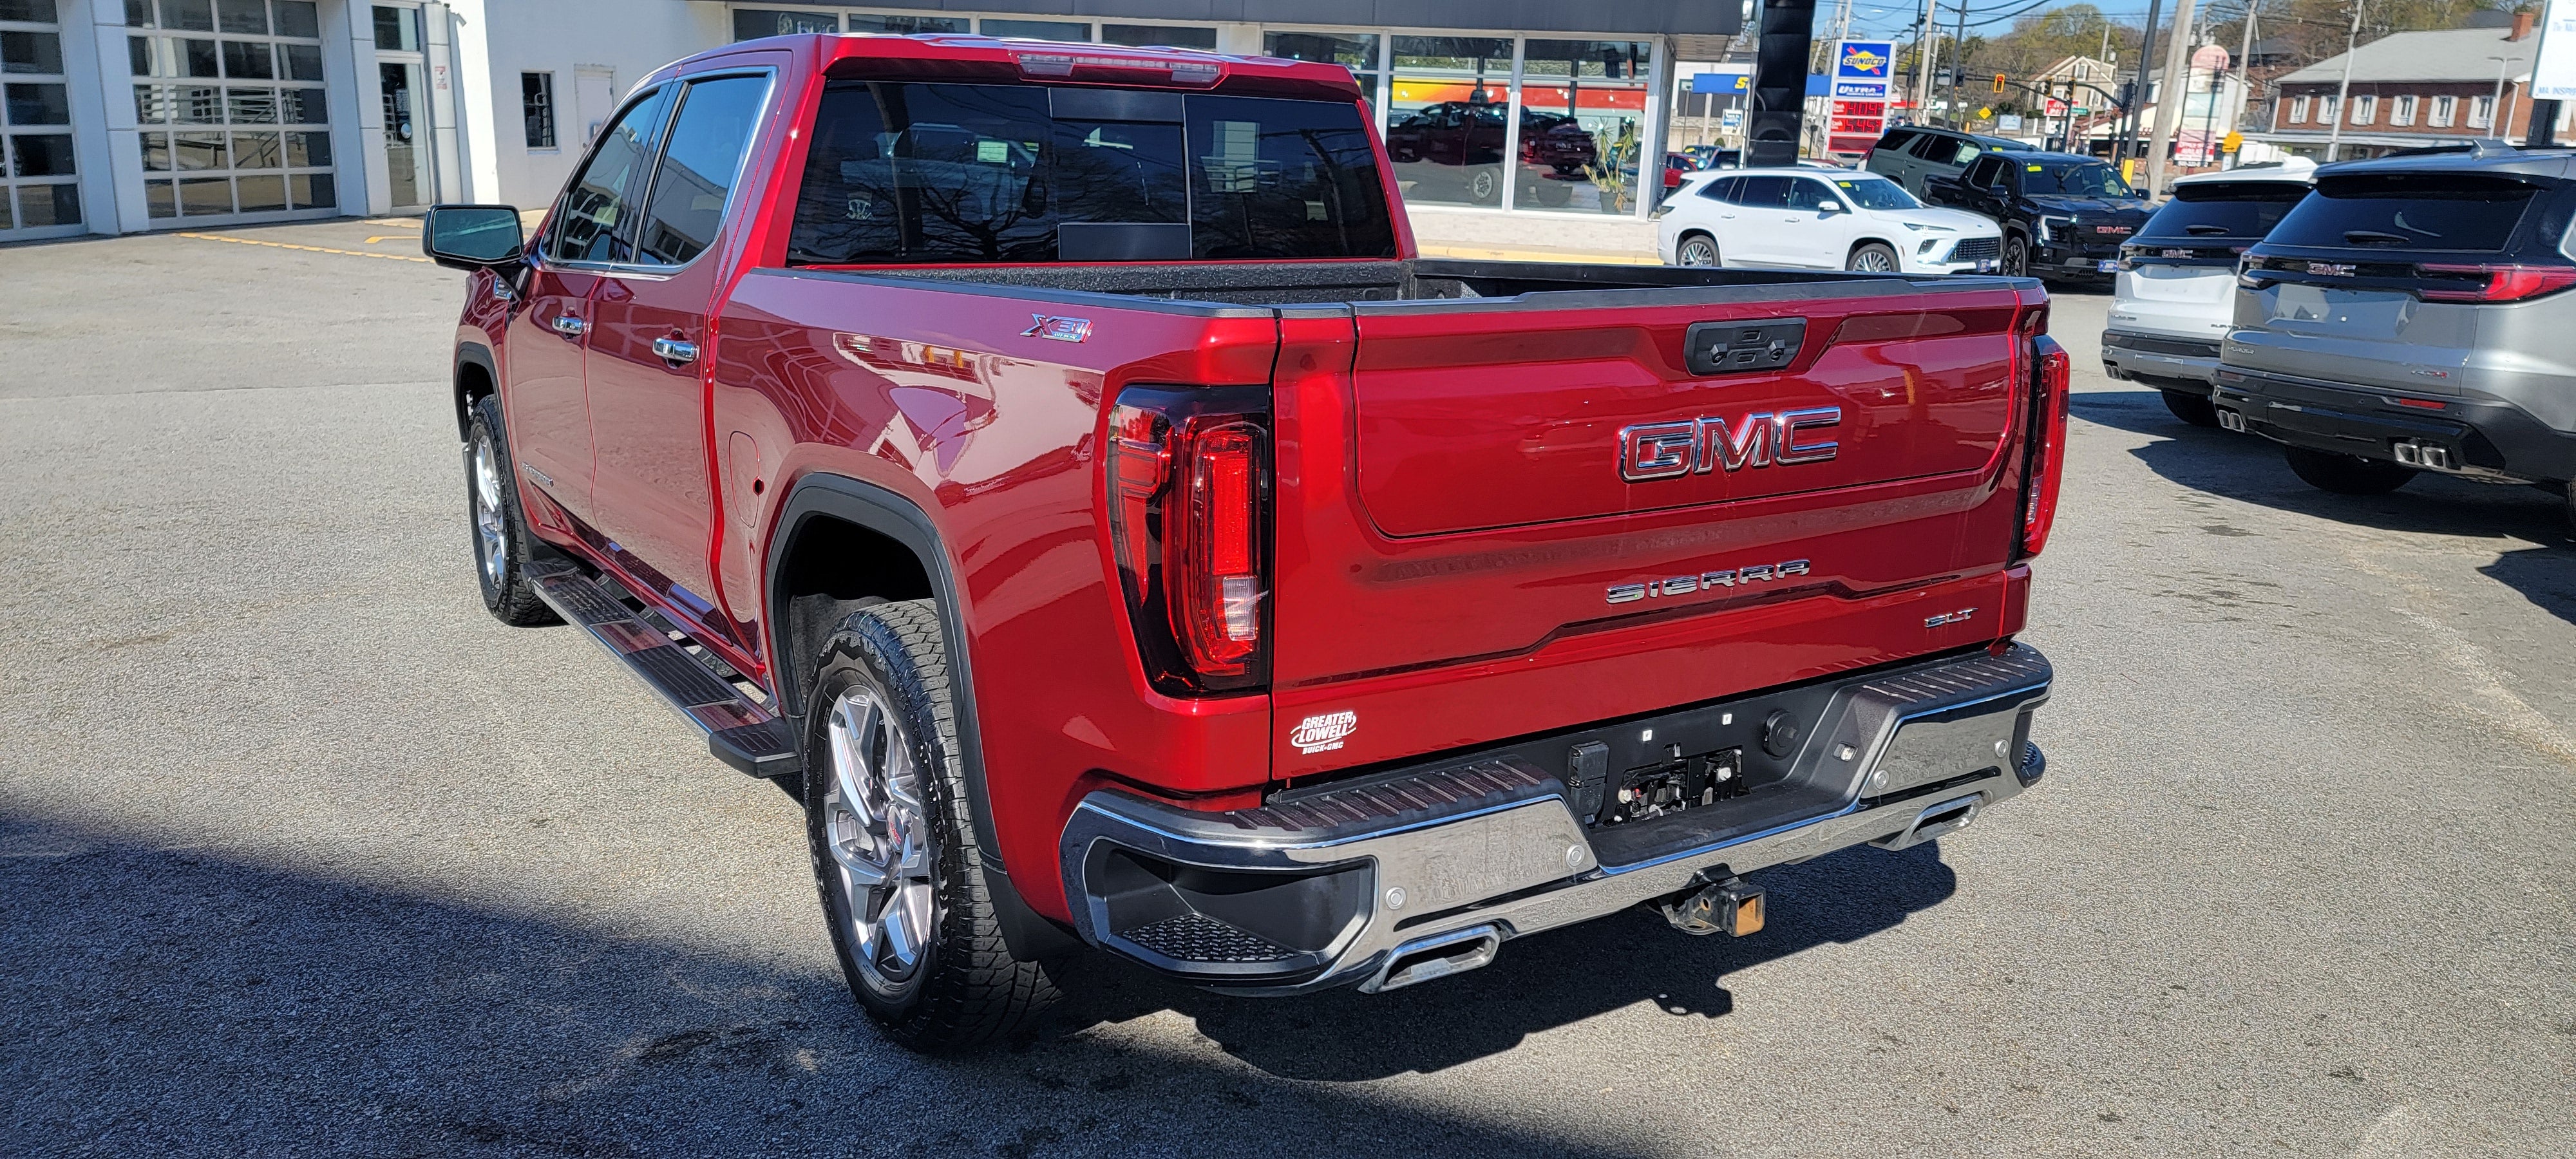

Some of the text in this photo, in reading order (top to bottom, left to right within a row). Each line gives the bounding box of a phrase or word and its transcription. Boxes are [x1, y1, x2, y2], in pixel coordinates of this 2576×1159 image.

[1844, 57, 1885, 66] SUNOCO
[2161, 249, 2193, 259] GMC
[2307, 263, 2356, 278] GMC
[1617, 406, 1841, 482] GMC
[1606, 559, 1811, 603] SIERRA
[1924, 607, 1979, 628] SLT
[1302, 711, 1354, 730] GREATER
[1298, 723, 1349, 744] LOWELL
